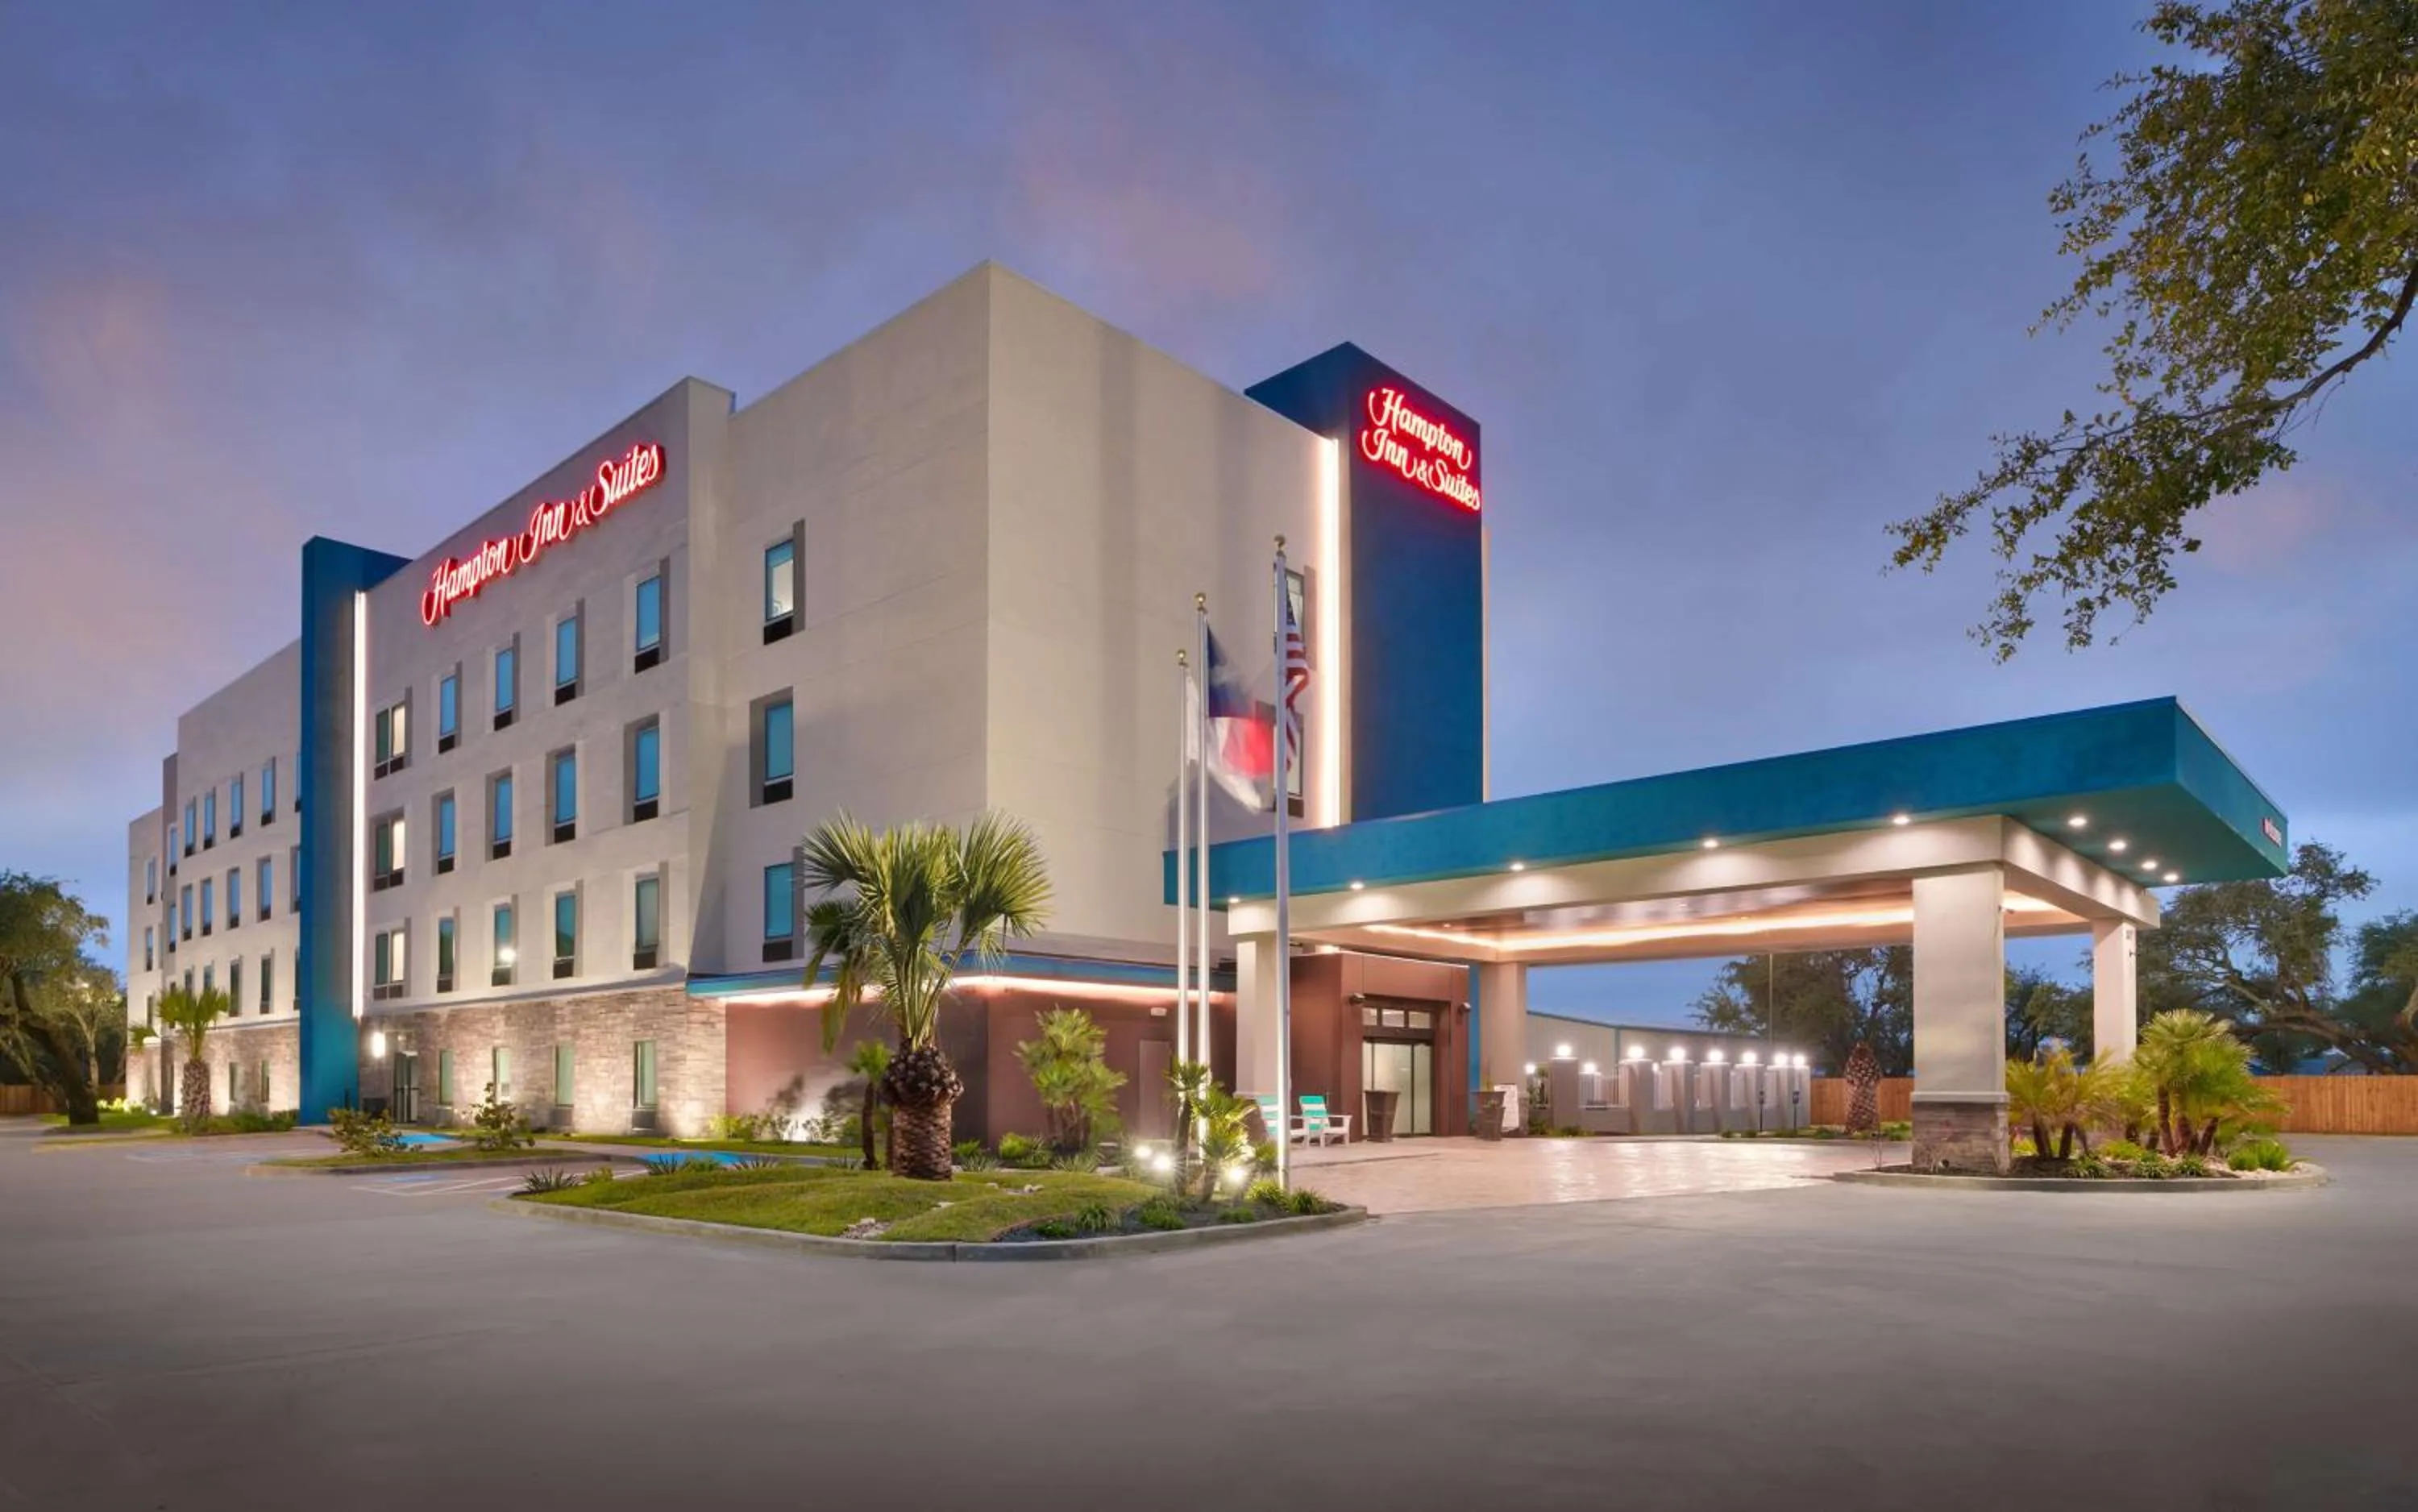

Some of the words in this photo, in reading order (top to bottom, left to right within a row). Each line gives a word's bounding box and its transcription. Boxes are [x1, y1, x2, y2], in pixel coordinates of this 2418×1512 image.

[1361, 427, 1417, 478] Inn
[1416, 459, 1431, 488] &
[1427, 459, 1481, 510] Suites
[1368, 387, 1472, 470] Hampton
[421, 535, 517, 625] Hampton
[518, 501, 575, 563] Inn
[575, 490, 591, 525] &
[589, 443, 662, 516] Suites
